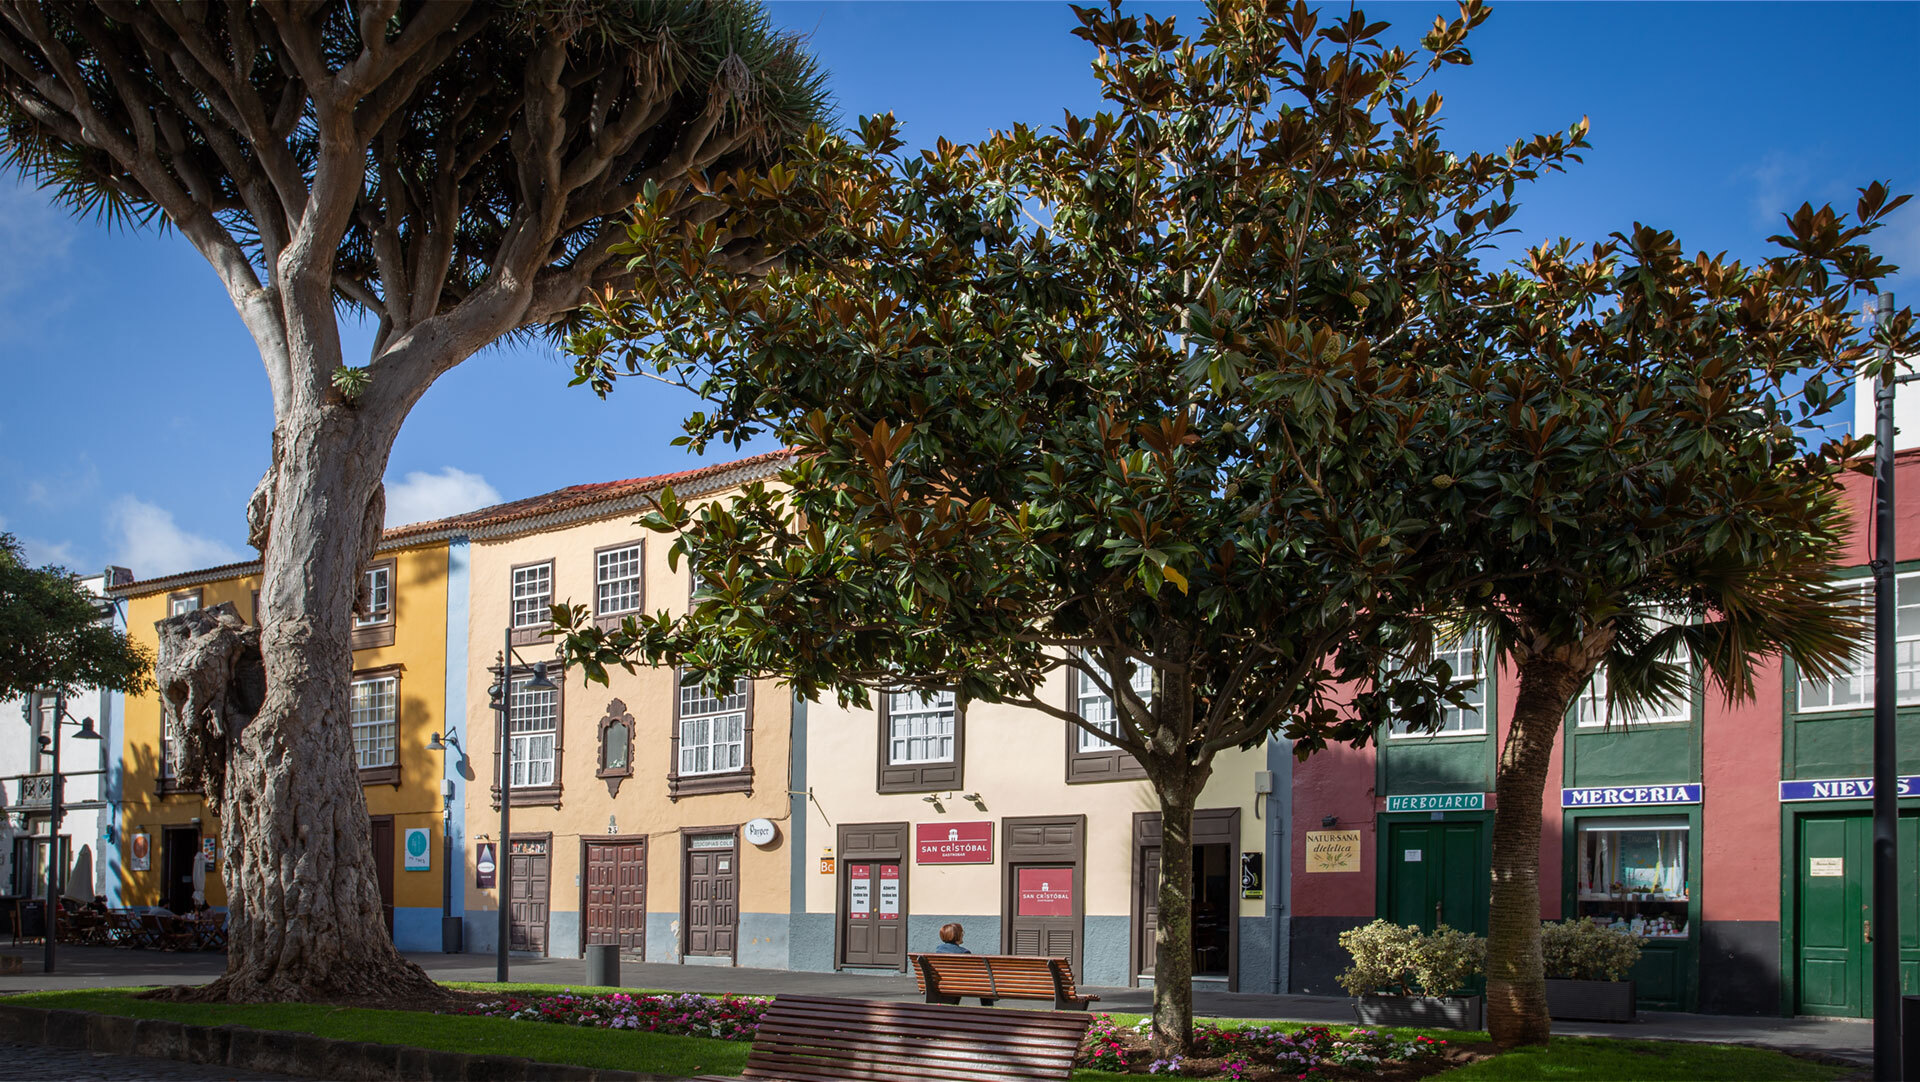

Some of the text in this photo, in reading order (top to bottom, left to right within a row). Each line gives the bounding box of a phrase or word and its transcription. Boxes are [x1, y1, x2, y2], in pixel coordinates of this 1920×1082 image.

[1571, 787, 1690, 804] MERCERIA
[1812, 779, 1910, 798] NIEVS
[1392, 796, 1478, 810] HERBOLARIO
[940, 843, 987, 852] CRISTÓBAL
